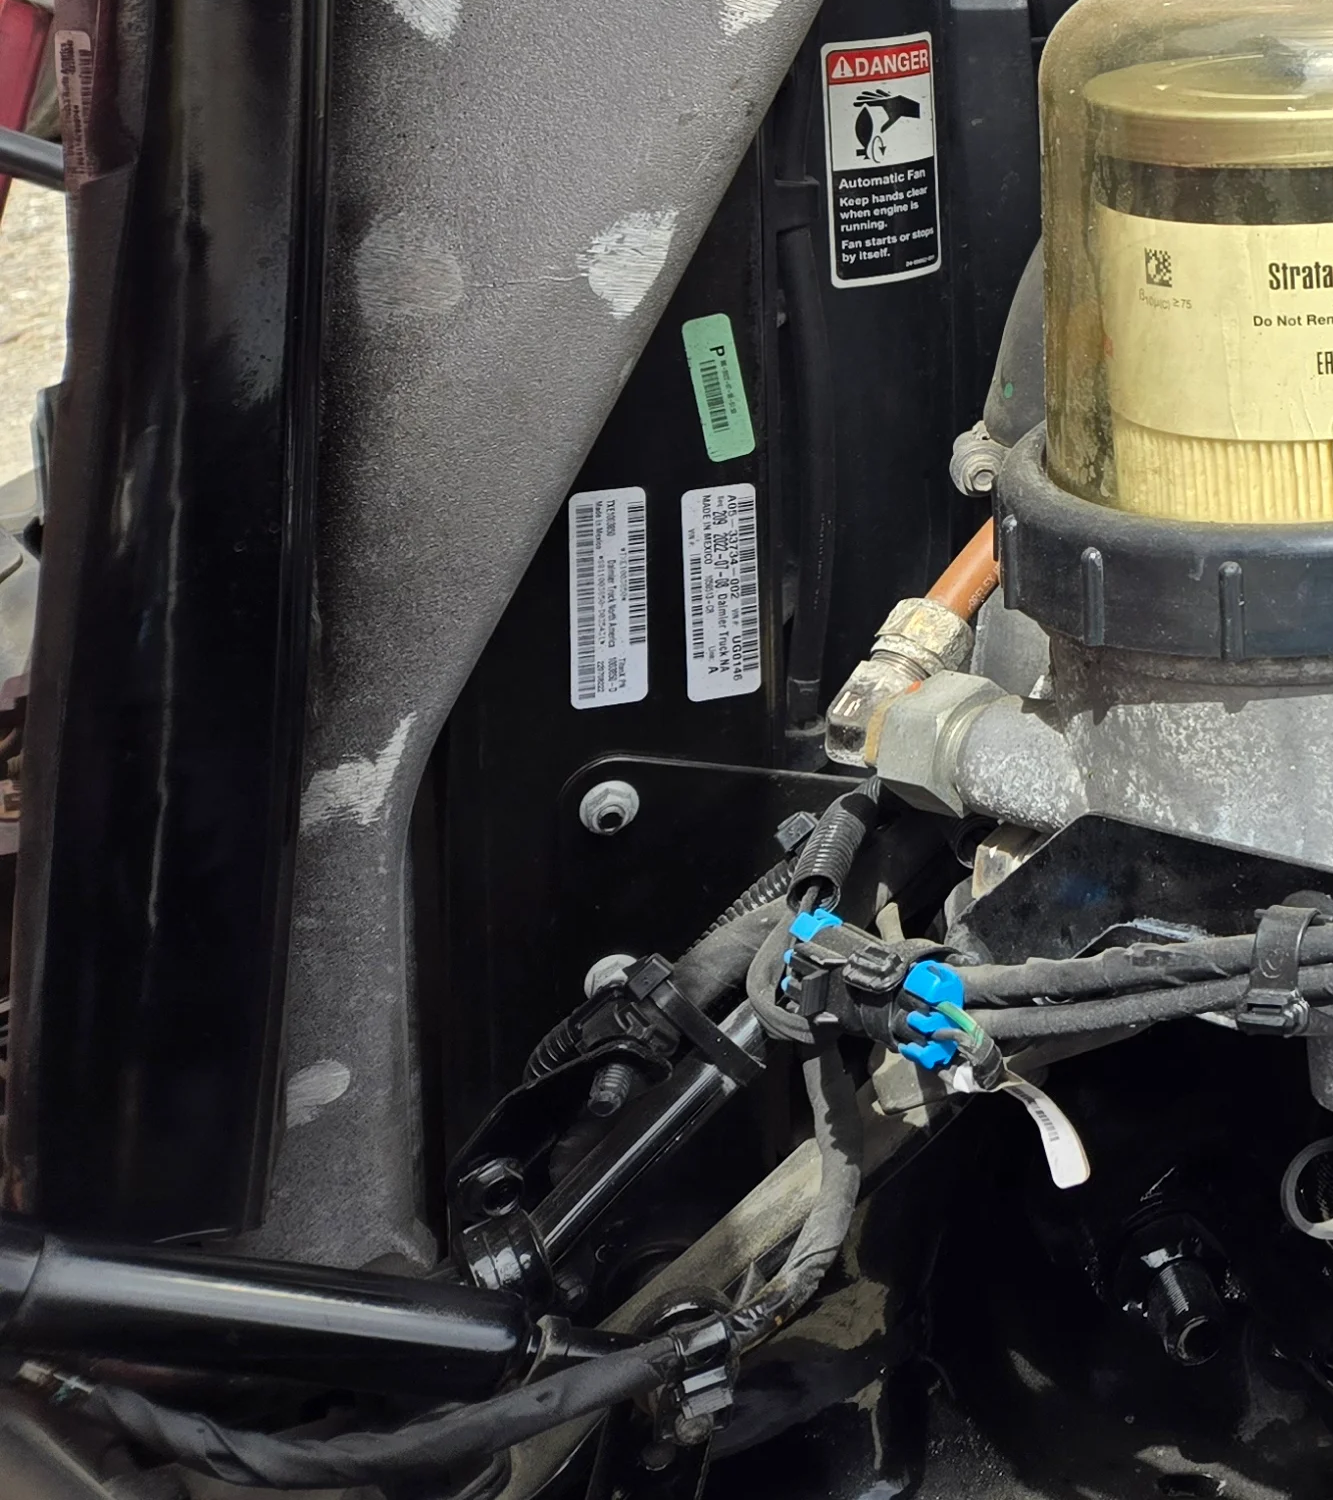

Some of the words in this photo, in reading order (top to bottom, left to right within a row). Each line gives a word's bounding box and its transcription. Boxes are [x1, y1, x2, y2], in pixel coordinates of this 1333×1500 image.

[855, 49, 929, 77] DANGER
[839, 172, 905, 189] Automatic
[908, 168, 926, 181] Fan
[840, 196, 869, 209] Keep
[872, 192, 904, 204] hands
[907, 186, 928, 198] clear
[840, 208, 871, 220] when
[873, 204, 908, 217] engine
[911, 201, 919, 211] is
[841, 220, 888, 233] running.
[842, 238, 862, 250] Fan
[865, 235, 897, 247] starts
[900, 232, 910, 242] or
[912, 227, 934, 240] stops
[842, 251, 856, 264] by
[859, 247, 890, 260] itself.
[1253, 315, 1272, 327] Do
[1277, 314, 1302, 327] Not
[710, 346, 725, 356] P
[703, 495, 711, 519] MADE
[713, 510, 727, 525] 209
[704, 522, 711, 530] IN
[704, 533, 713, 564] MEXICO
[714, 533, 729, 588] 2022-07-08
[608, 560, 616, 583] Daimler
[608, 586, 617, 602] Truck
[608, 604, 617, 621] North
[718, 594, 728, 628] Daimler
[608, 623, 617, 648] America
[719, 631, 730, 656] Truck
[720, 659, 730, 673] NA
[732, 636, 742, 681] UG0146
[708, 666, 719, 674] A
